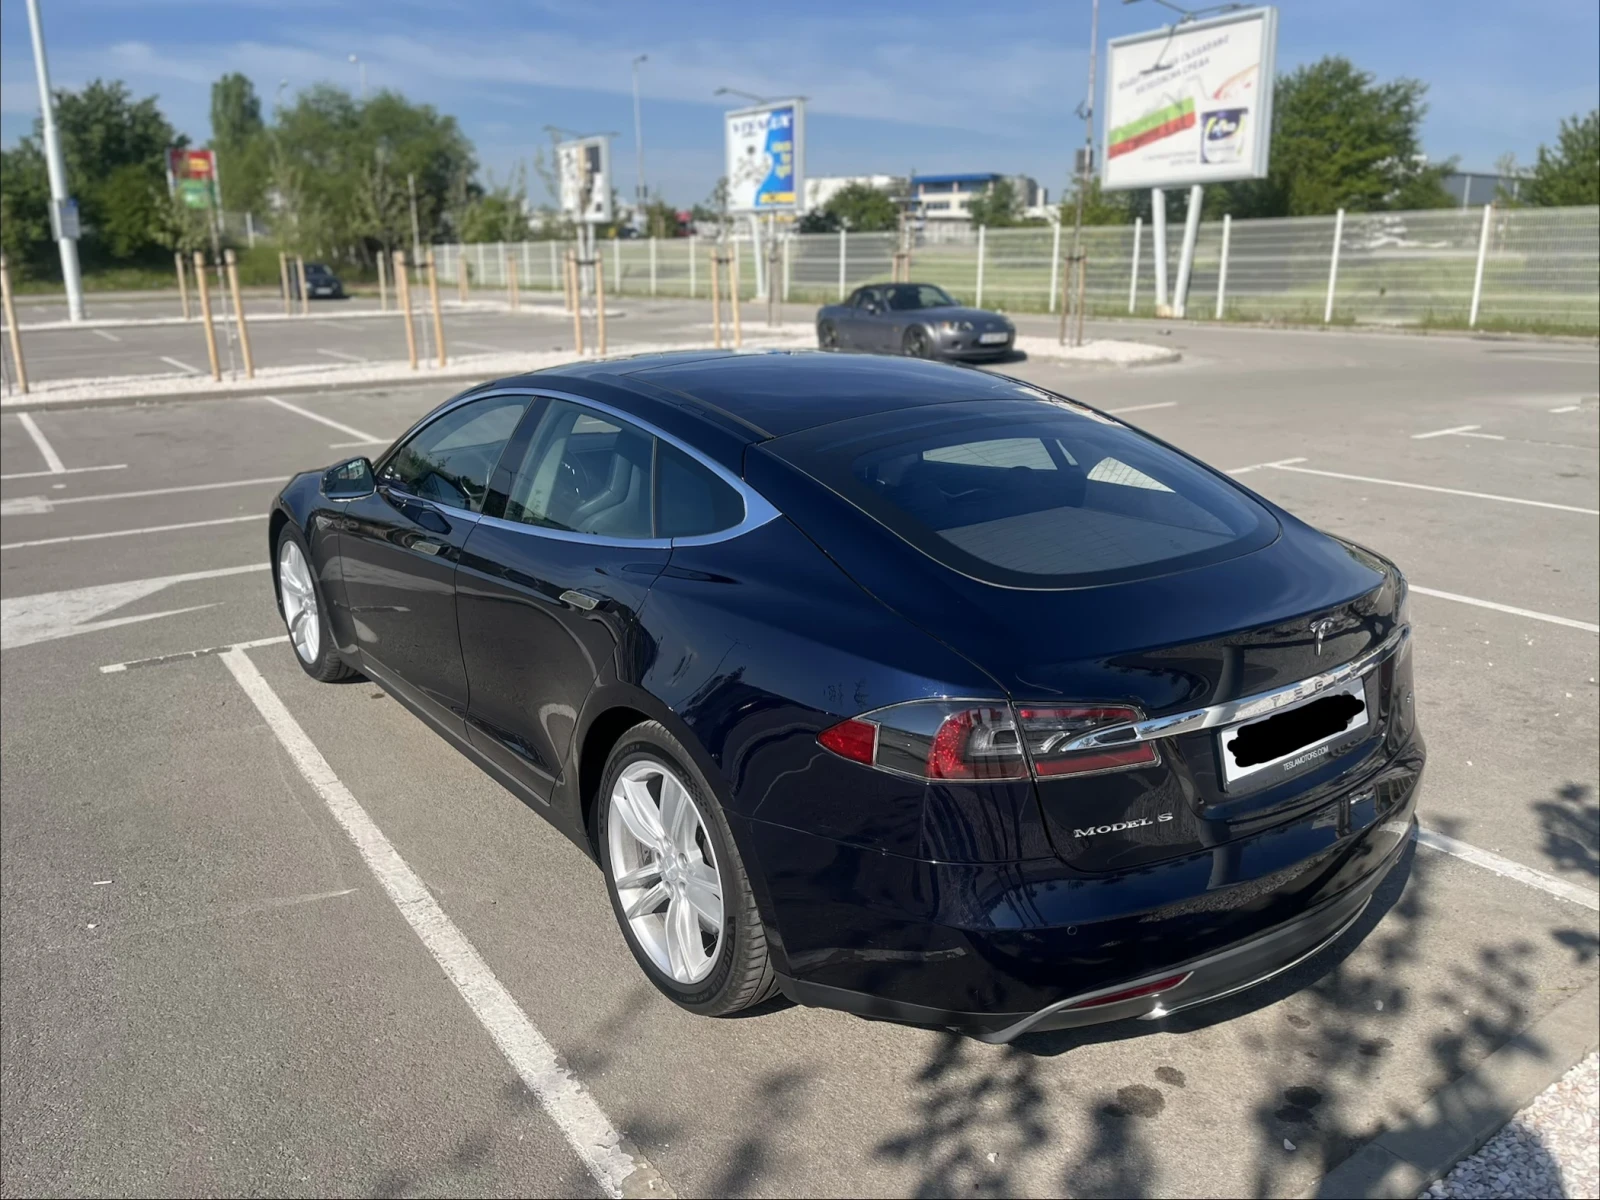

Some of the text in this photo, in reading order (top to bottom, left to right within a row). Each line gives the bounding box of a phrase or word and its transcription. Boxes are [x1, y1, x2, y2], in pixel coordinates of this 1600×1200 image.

[1283, 745, 1329, 771] TESLAMOTORS.COM
[1073, 812, 1174, 838] MODEL S
